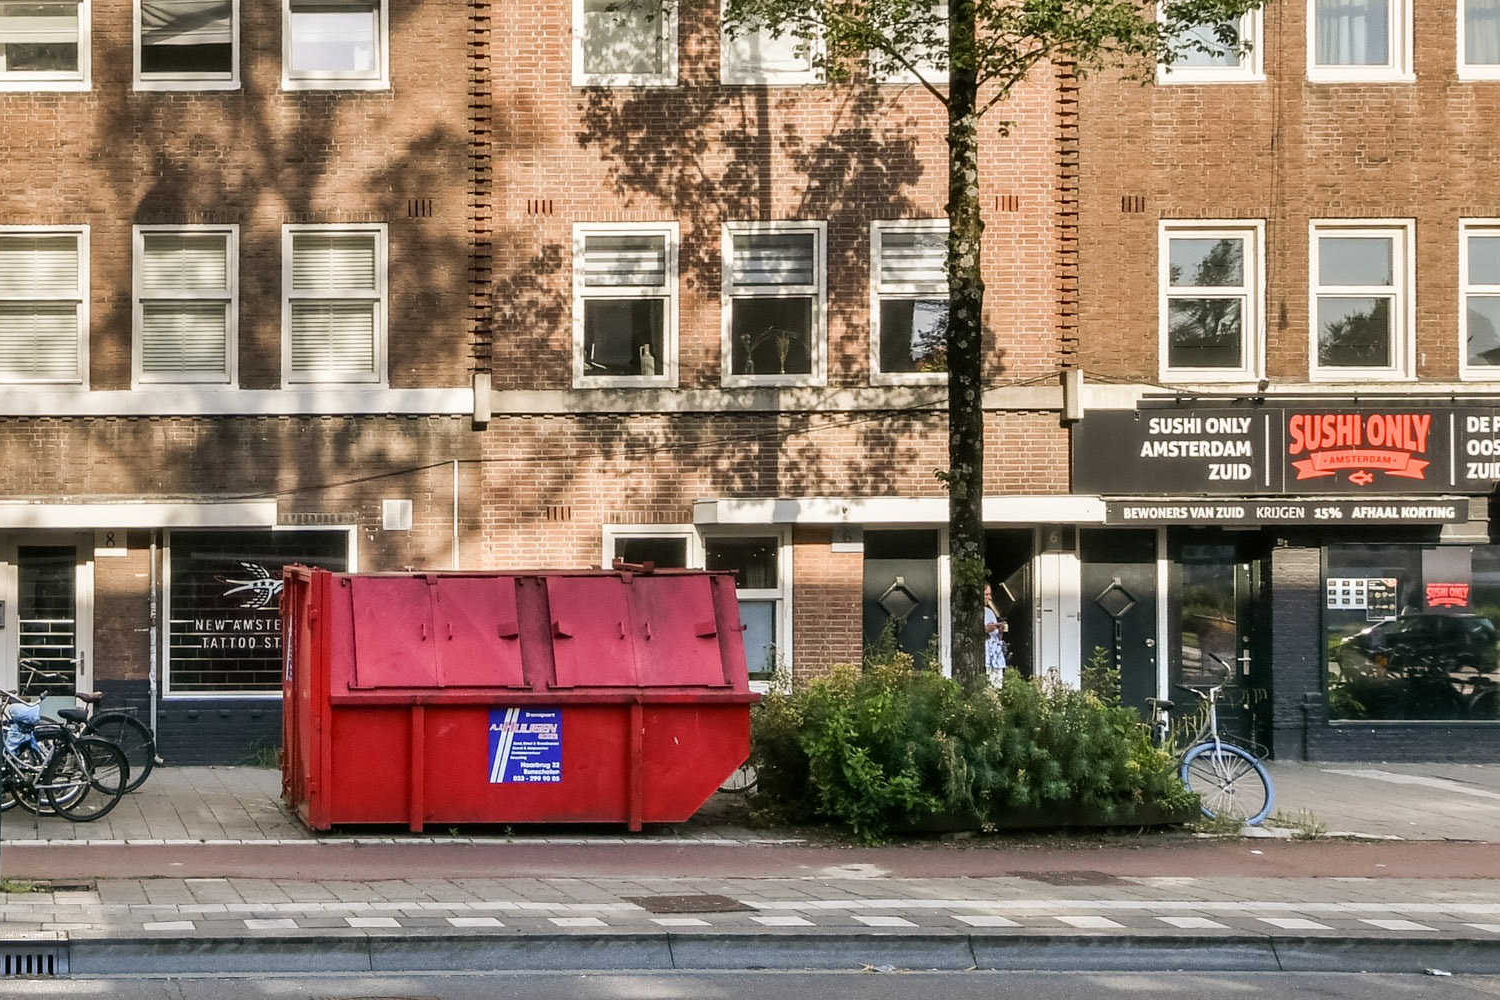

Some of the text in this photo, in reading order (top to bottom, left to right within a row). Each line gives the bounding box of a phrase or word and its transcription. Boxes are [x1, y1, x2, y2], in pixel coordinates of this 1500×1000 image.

[1149, 417, 1252, 434] SUSHI ONLY
[1466, 416, 1490, 433] DE
[1289, 414, 1431, 454] SUSHI ONLY
[1140, 441, 1252, 457] AMSTERDAM
[1329, 456, 1392, 464] AMSTERDAM
[1208, 464, 1252, 480] ZUID
[1123, 507, 1456, 519] BEWONERS VAN ZUID KRIJGEN 15% AFHAAL KORTING
[106, 531, 115, 548] 8
[1049, 530, 1058, 543] 6
[1426, 587, 1469, 599] SUSHI ONLY
[195, 619, 225, 630] NEW
[202, 637, 256, 648] TATTOO
